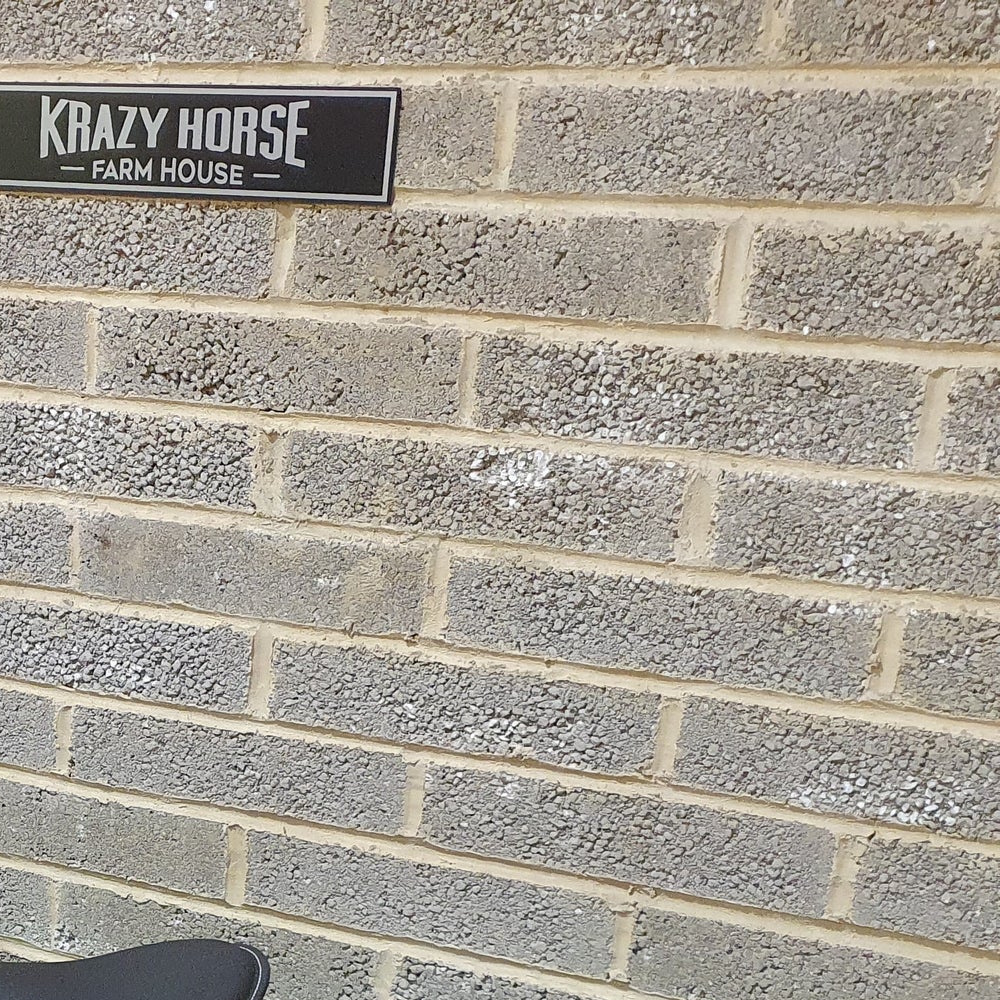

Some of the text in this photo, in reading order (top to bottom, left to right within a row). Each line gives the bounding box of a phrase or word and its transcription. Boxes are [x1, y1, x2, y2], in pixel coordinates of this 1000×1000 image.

[40, 95, 310, 168] KRAZY HORSE
[92, 158, 244, 185] FARM HOUSE
